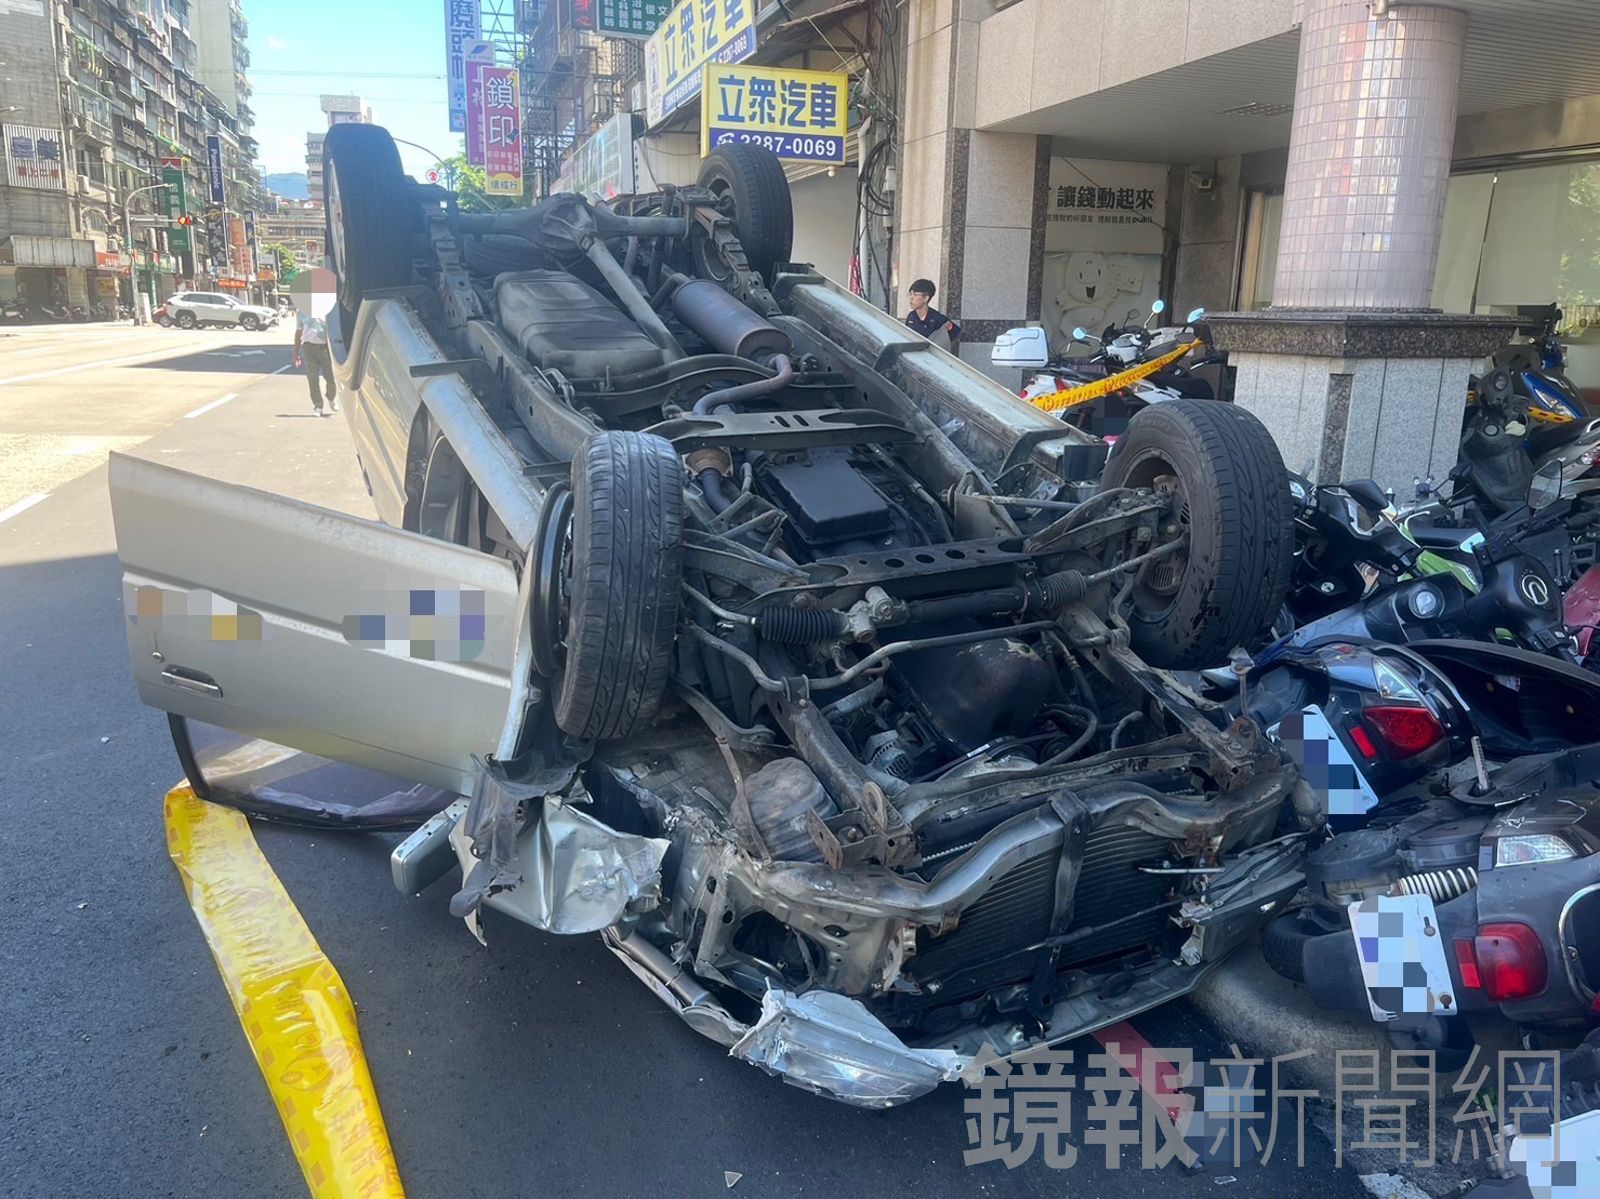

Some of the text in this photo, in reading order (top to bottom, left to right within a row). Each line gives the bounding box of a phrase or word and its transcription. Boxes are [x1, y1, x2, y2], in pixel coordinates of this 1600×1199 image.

[486, 76, 514, 147] 鎖印
[717, 74, 837, 129] 立眾汽車
[1057, 186, 1155, 210] 讓錢動起來
